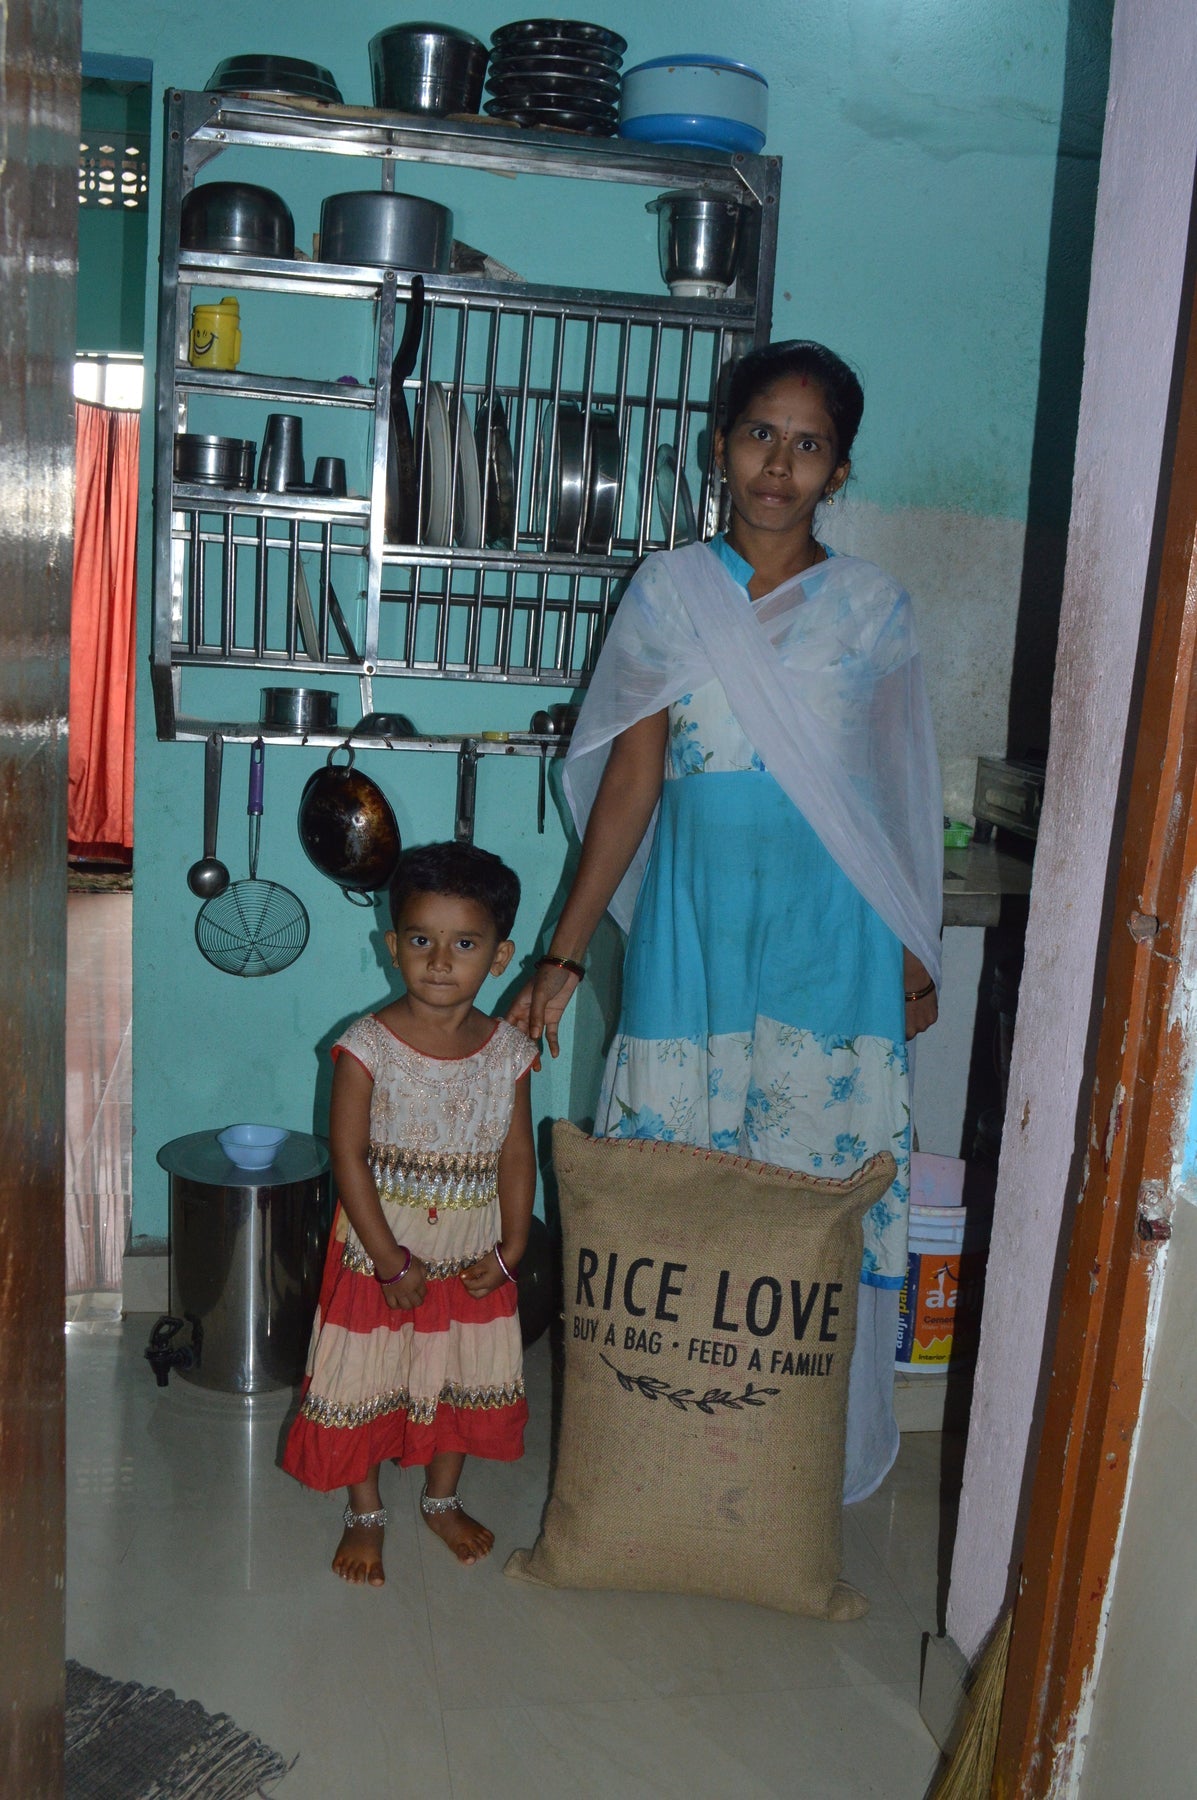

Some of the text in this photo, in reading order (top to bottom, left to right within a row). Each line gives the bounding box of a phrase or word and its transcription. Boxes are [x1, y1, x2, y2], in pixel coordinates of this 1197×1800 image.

[575, 1247, 843, 1342] RICE LOVE
[573, 1316, 834, 1376] BUY A BAG FEED A FAMILY
